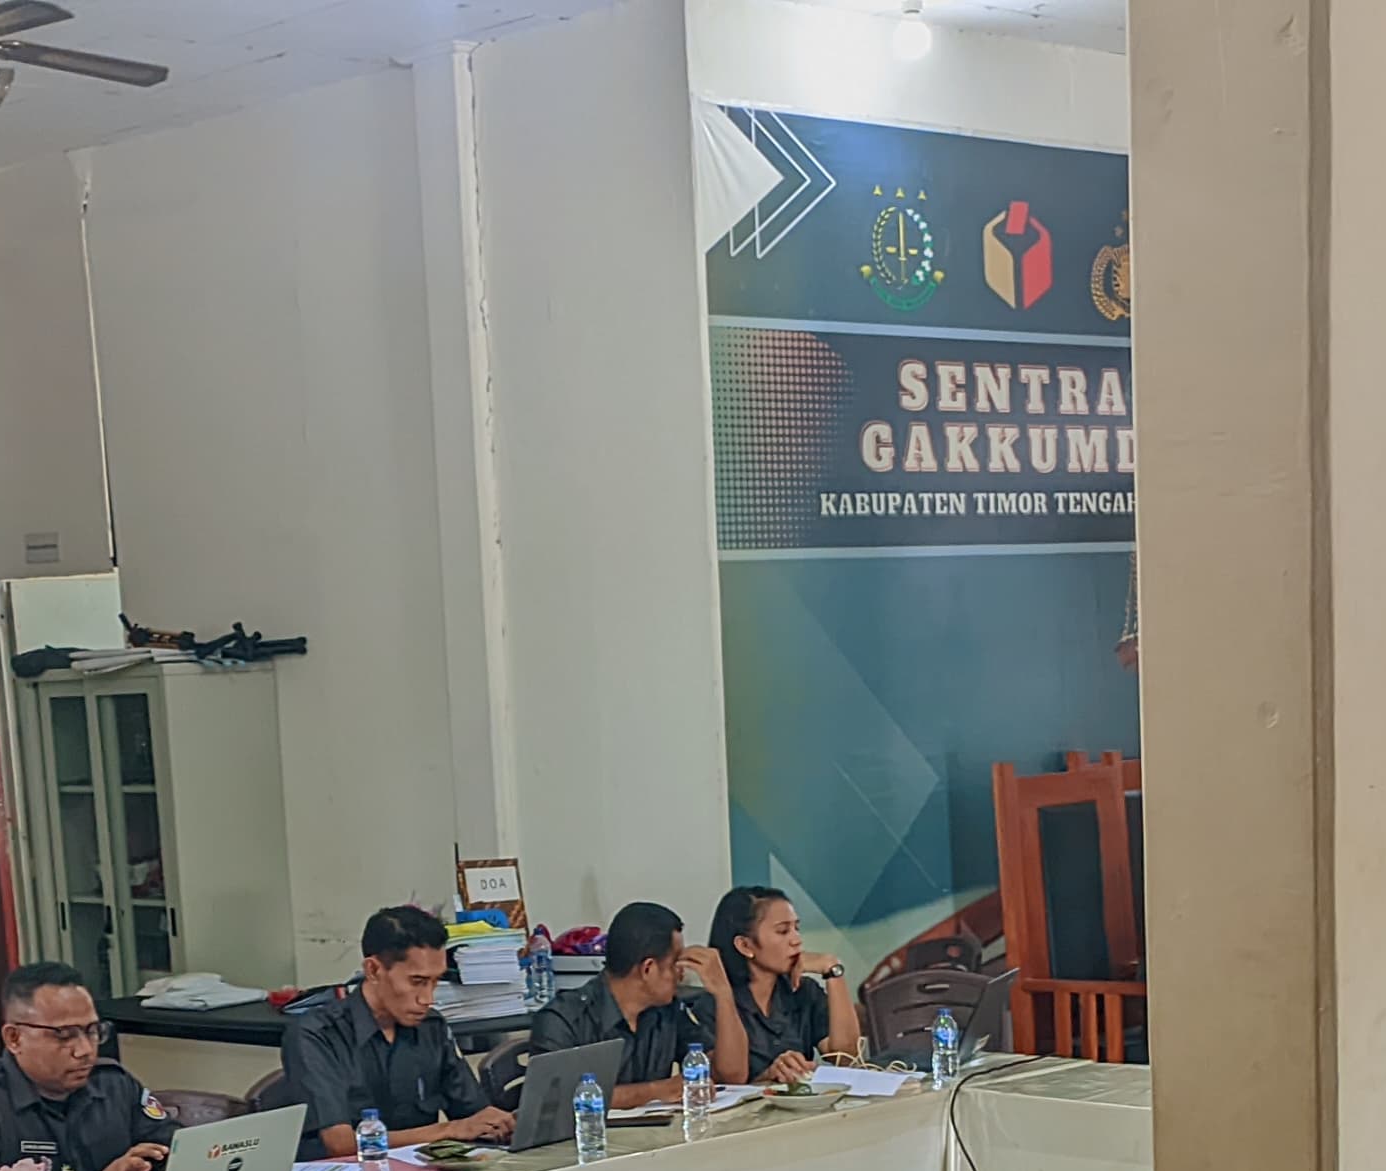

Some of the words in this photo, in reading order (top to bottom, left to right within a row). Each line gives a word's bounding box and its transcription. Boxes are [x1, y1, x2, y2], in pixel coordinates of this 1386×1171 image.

[898, 359, 1127, 415] SENTRA
[821, 493, 965, 515] KABUPATEN
[973, 493, 1047, 514] TIMOR
[481, 878, 507, 890] DOA
